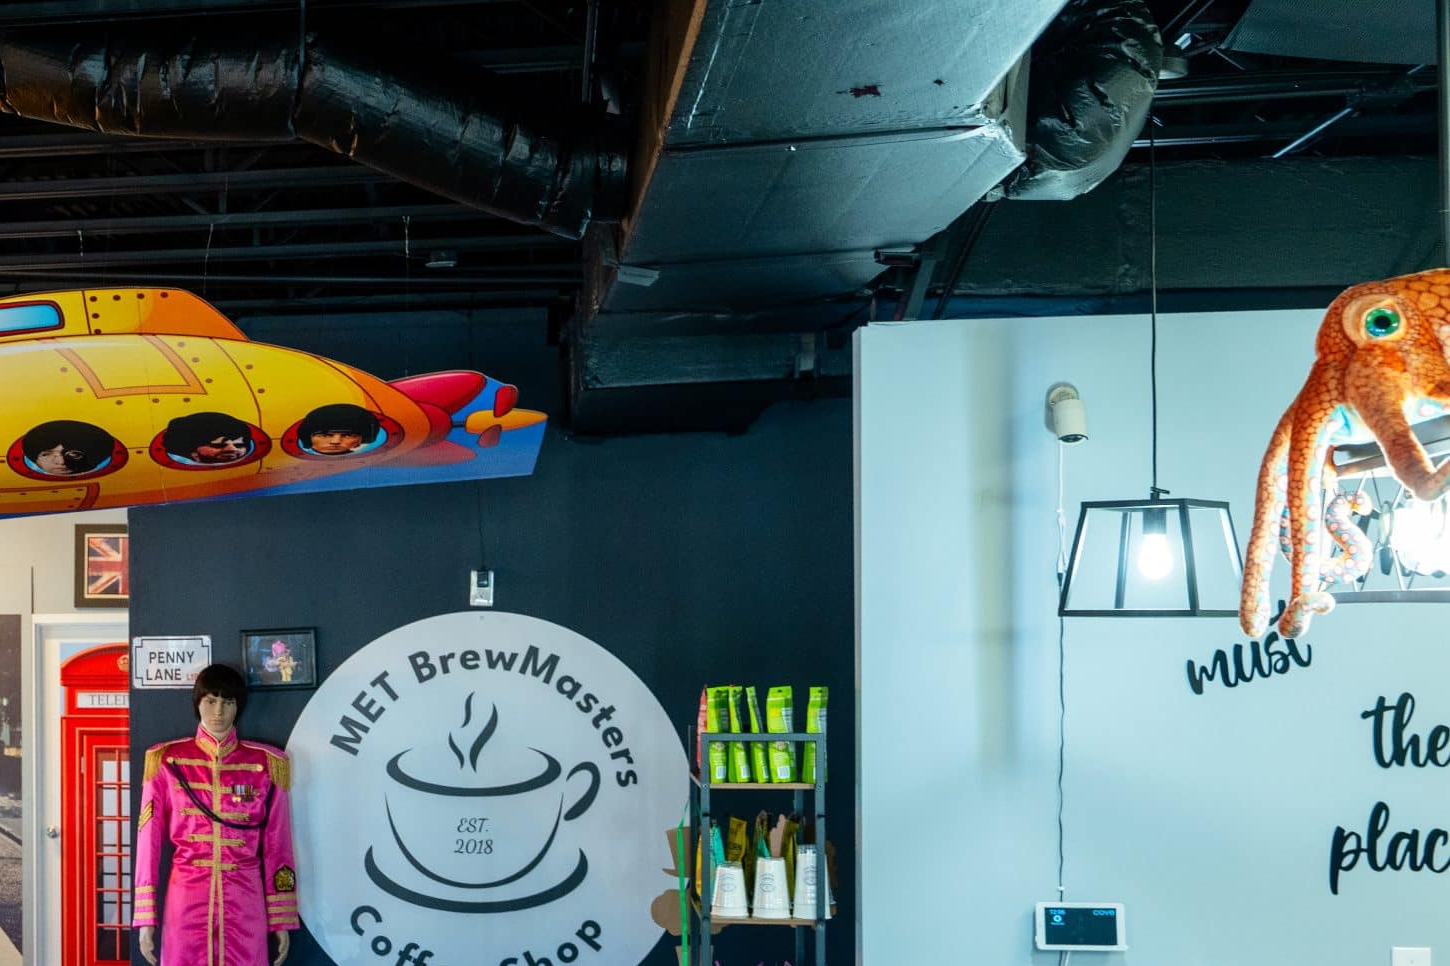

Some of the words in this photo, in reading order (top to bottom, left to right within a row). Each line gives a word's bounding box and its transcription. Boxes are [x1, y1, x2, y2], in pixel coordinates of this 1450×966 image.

[149, 651, 195, 664] PENNY
[146, 668, 182, 681] LANE
[329, 670, 400, 757] MET
[408, 645, 639, 788] BrewMasters
[1361, 691, 1450, 769] the
[457, 817, 490, 833] EST.
[454, 838, 493, 855] 2018
[1328, 800, 1450, 896] plac
